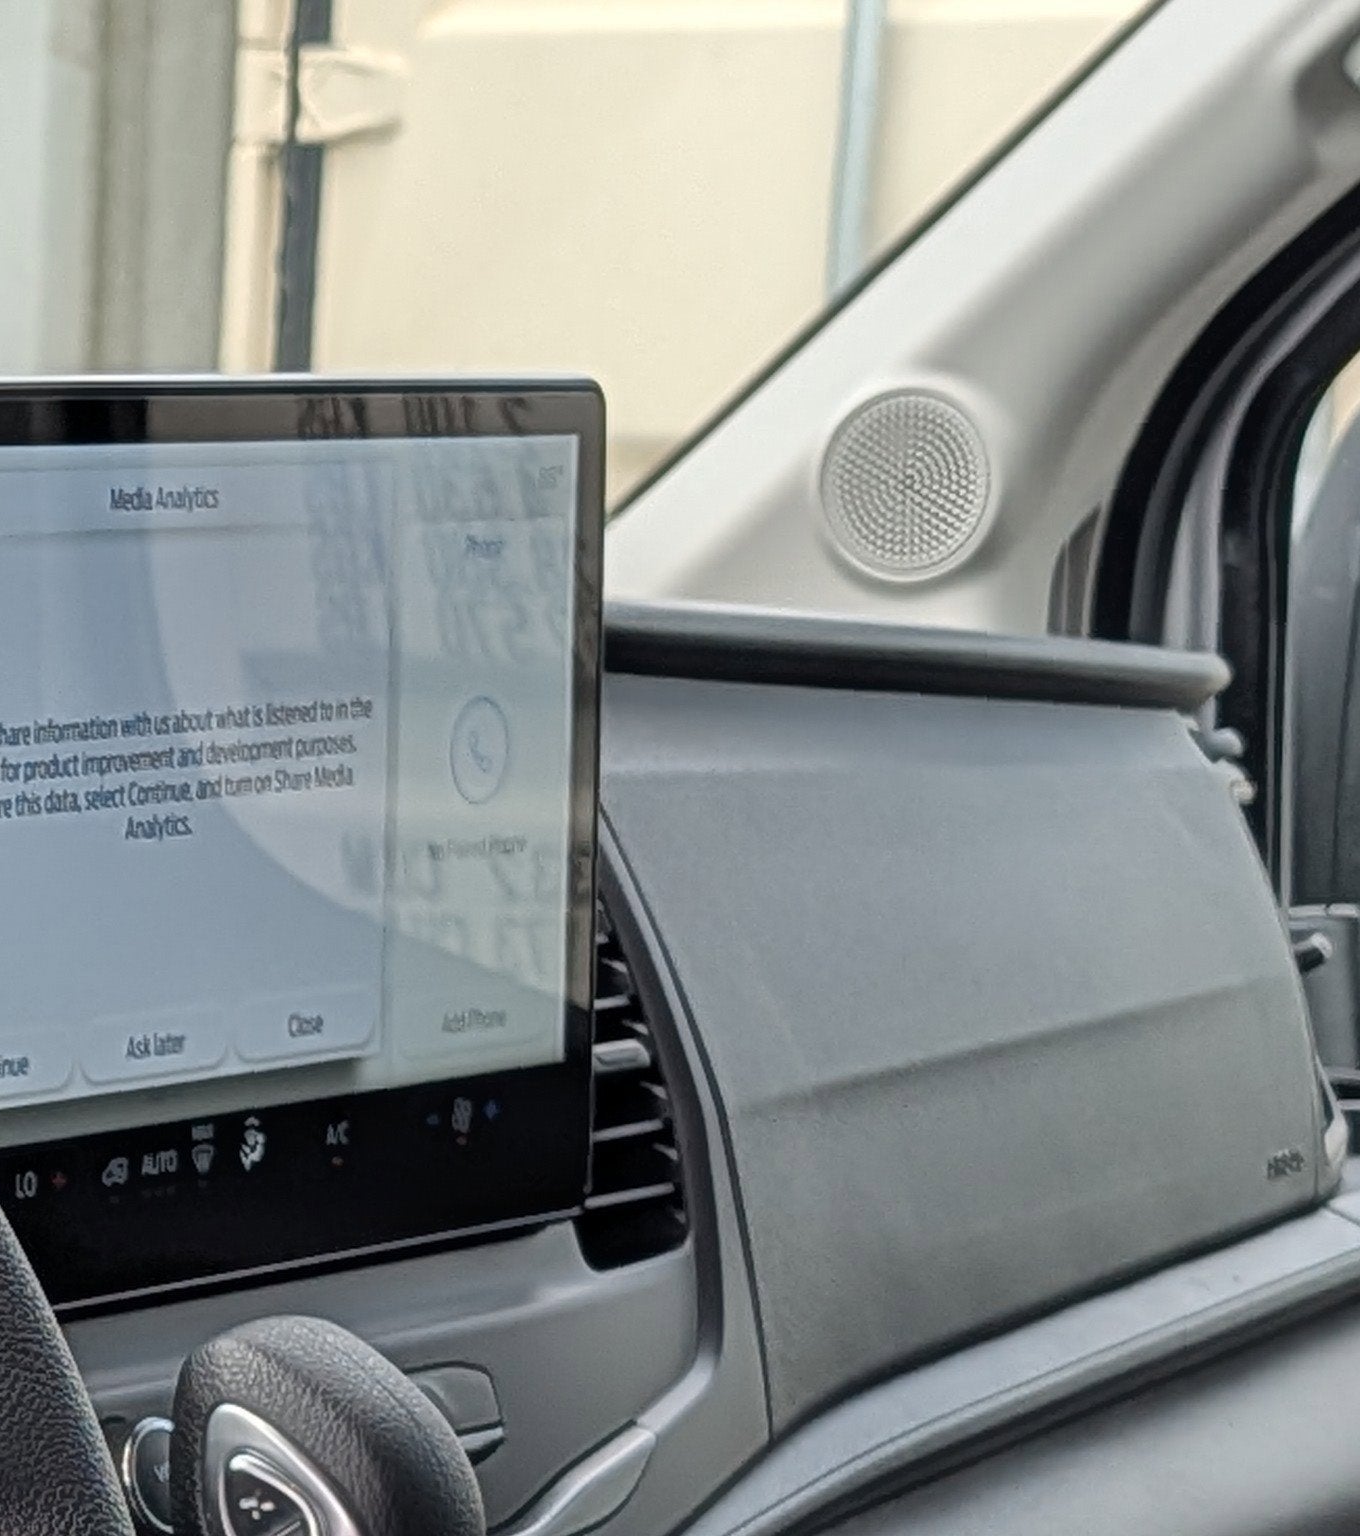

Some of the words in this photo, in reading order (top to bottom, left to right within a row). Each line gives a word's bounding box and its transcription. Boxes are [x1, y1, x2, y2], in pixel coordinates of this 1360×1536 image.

[110, 487, 153, 511] Media
[156, 485, 219, 512] Analytics
[33, 715, 118, 745] information
[120, 711, 152, 738] with
[154, 714, 171, 735] us
[173, 709, 213, 734] about
[214, 706, 250, 730] what
[252, 705, 263, 726] is
[265, 702, 318, 726] listened
[320, 700, 333, 721] to
[335, 700, 349, 720] in
[350, 697, 373, 720] the
[0, 756, 21, 783] for
[23, 753, 79, 784] product
[81, 747, 175, 777] improvement
[177, 741, 203, 768] and
[206, 737, 293, 766] development
[15, 791, 42, 817] this
[44, 788, 81, 815] data,
[84, 784, 125, 811] select
[196, 775, 223, 801] and
[254, 774, 272, 794] on
[274, 769, 312, 793] Share
[314, 764, 354, 788] Media
[288, 1012, 324, 1038] Close
[125, 1034, 151, 1060] Ask
[153, 1031, 186, 1056] later
[141, 1149, 178, 1176] AUTO
[14, 1170, 38, 1199] LO
